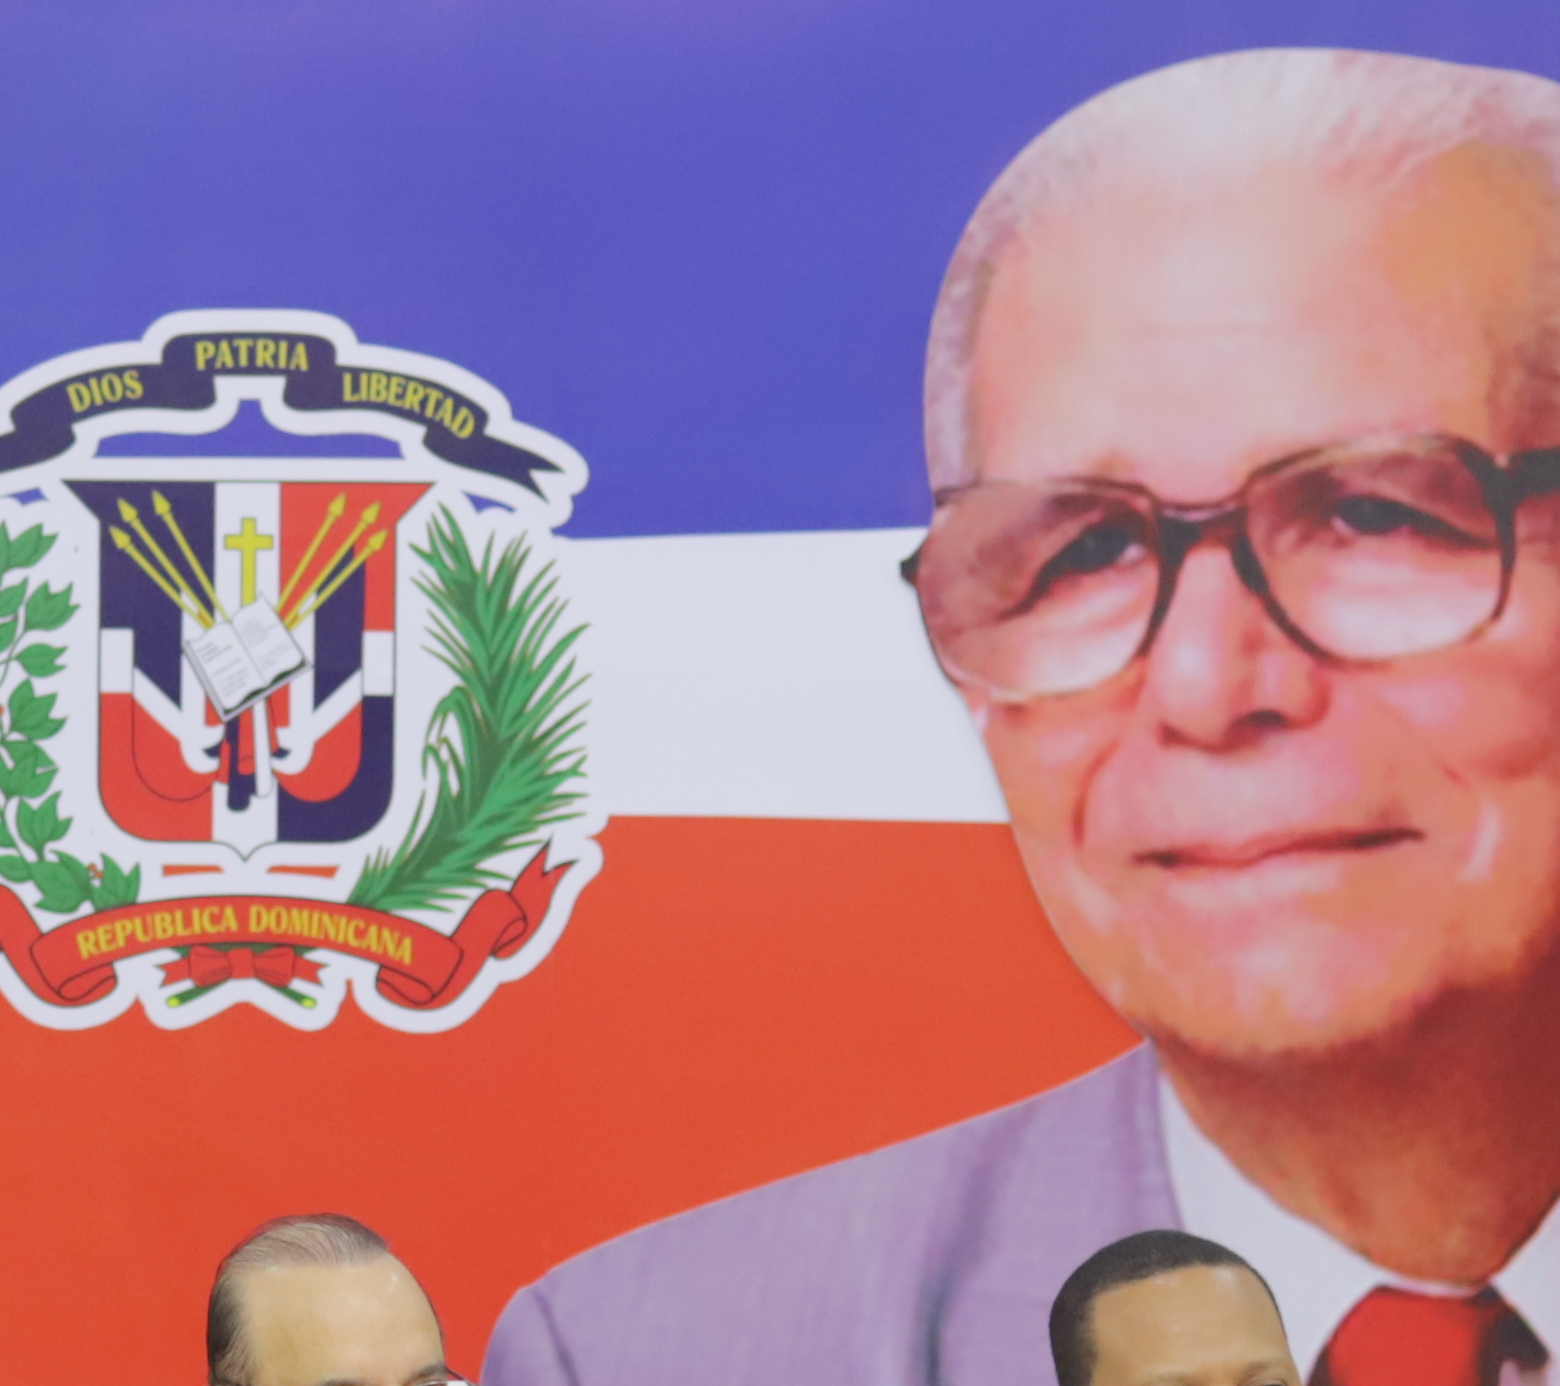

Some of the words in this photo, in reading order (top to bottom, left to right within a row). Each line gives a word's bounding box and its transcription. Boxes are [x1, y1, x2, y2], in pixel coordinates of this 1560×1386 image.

[67, 370, 143, 413] DIOS
[195, 339, 309, 372] PATRIA
[342, 372, 476, 440] LIBERTAD
[76, 907, 238, 960] REPUBLICA
[248, 908, 413, 966] DOMINICANA
